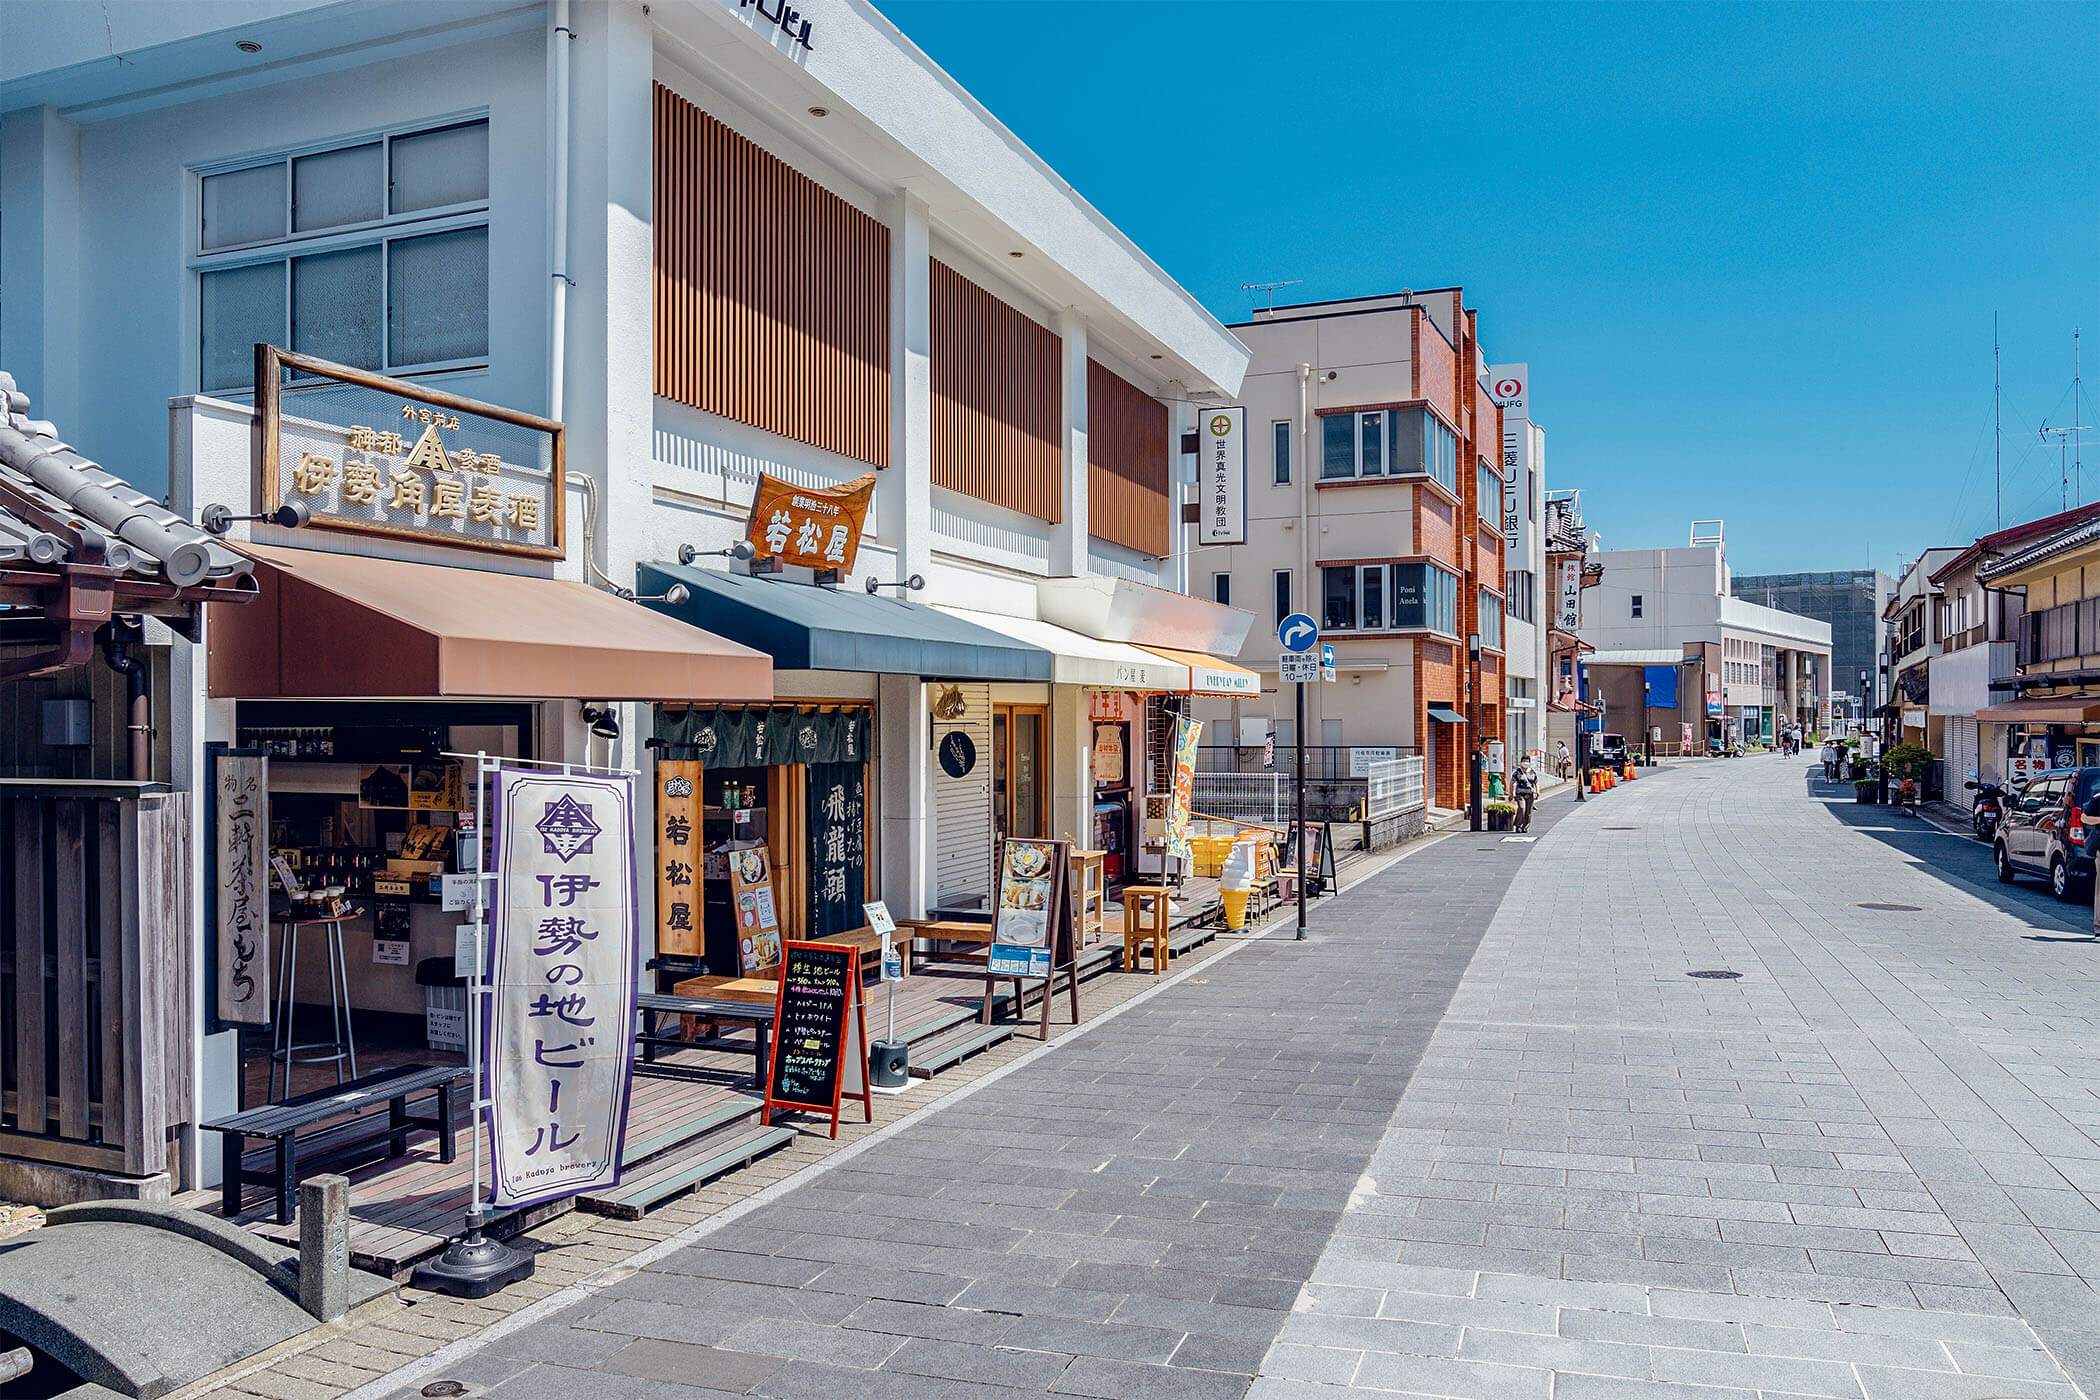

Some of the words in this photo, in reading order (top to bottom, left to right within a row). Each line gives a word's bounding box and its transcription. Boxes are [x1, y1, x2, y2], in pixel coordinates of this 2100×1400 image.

[402, 404, 460, 431] 外宮前店
[293, 450, 543, 531] 伊勢角屋麦酒
[1215, 439, 1226, 527] 世界真光文明教団
[791, 495, 840, 517] 創業明治三十八年
[765, 509, 849, 564] 若松屋
[1563, 585, 1577, 627] 山田館
[1282, 663, 1317, 671] 日曜・休日
[2015, 759, 2046, 770] 名物
[665, 815, 693, 932] 若松屋
[525, 874, 600, 1157] 伊勢の地ビール
[526, 1167, 555, 1179] Kadoya
[560, 1161, 597, 1172] brewery
